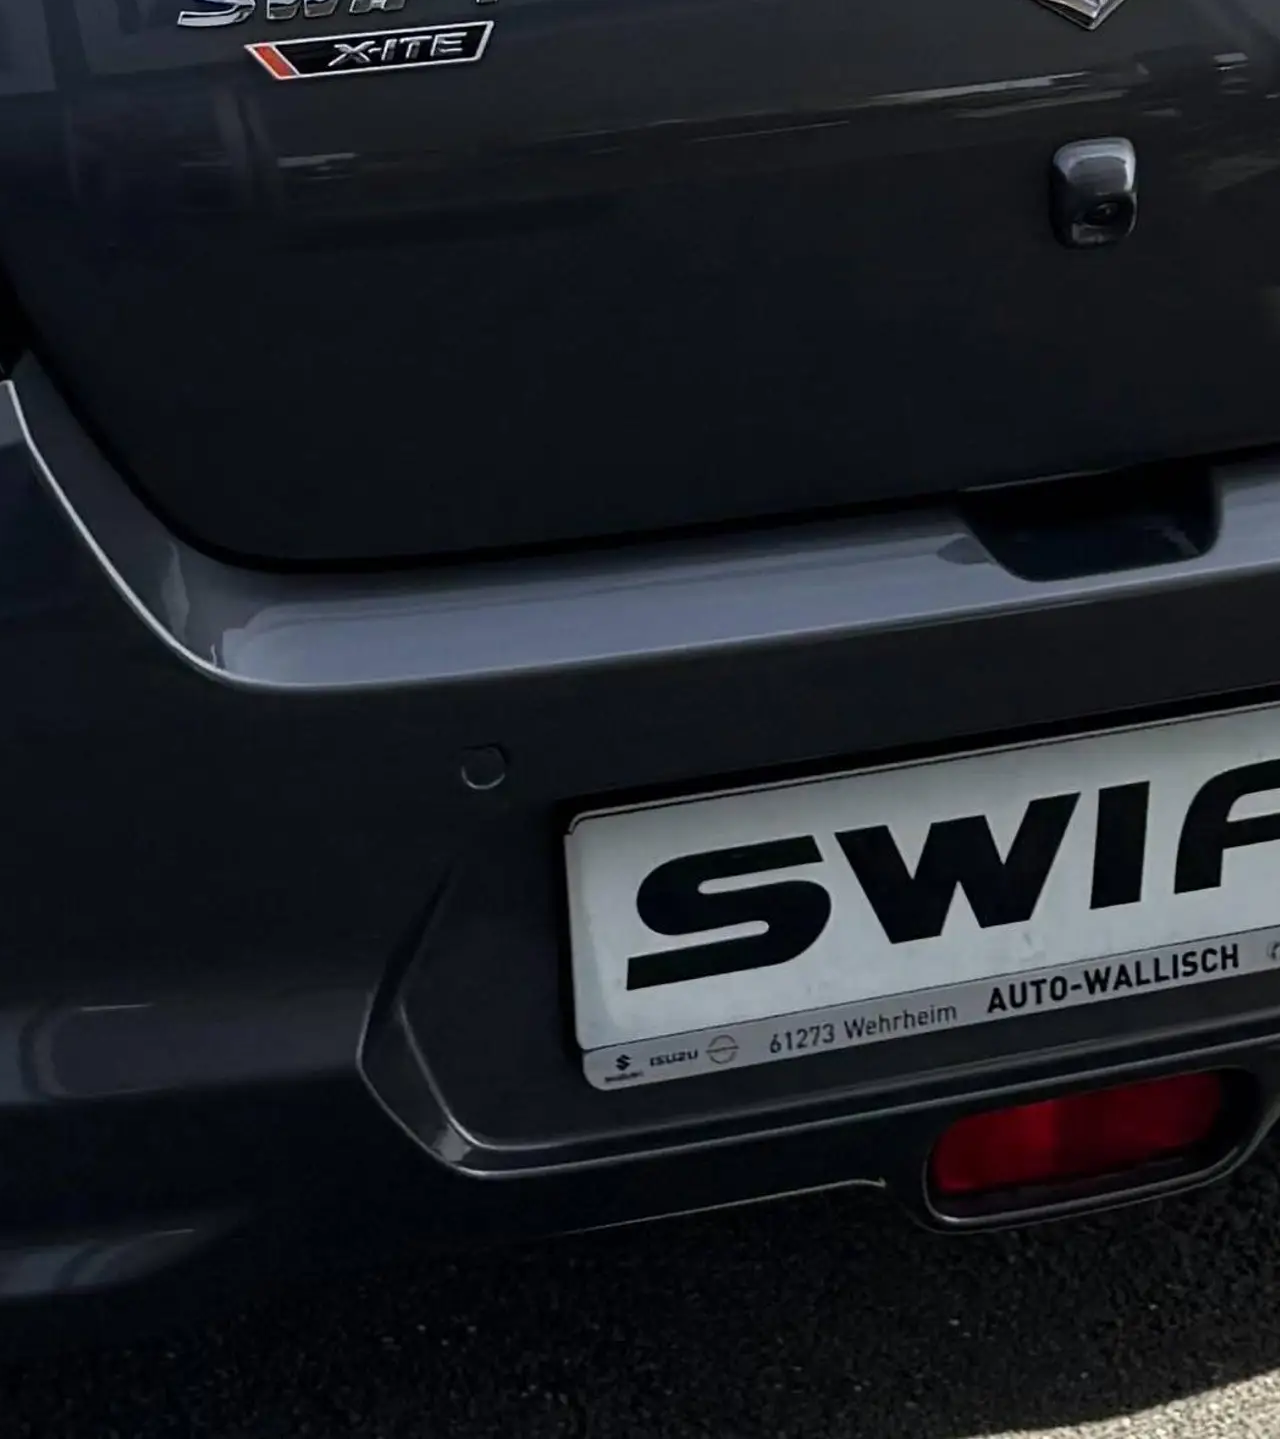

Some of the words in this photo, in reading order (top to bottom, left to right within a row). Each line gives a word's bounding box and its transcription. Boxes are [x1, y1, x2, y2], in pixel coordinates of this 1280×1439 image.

[328, 31, 468, 67] X-ITE
[769, 1021, 835, 1055] 61273
[843, 1003, 958, 1040] Wehrheim
[987, 943, 1240, 1014] AUTO-WALLISCH
[650, 1049, 699, 1067] ISUZU
